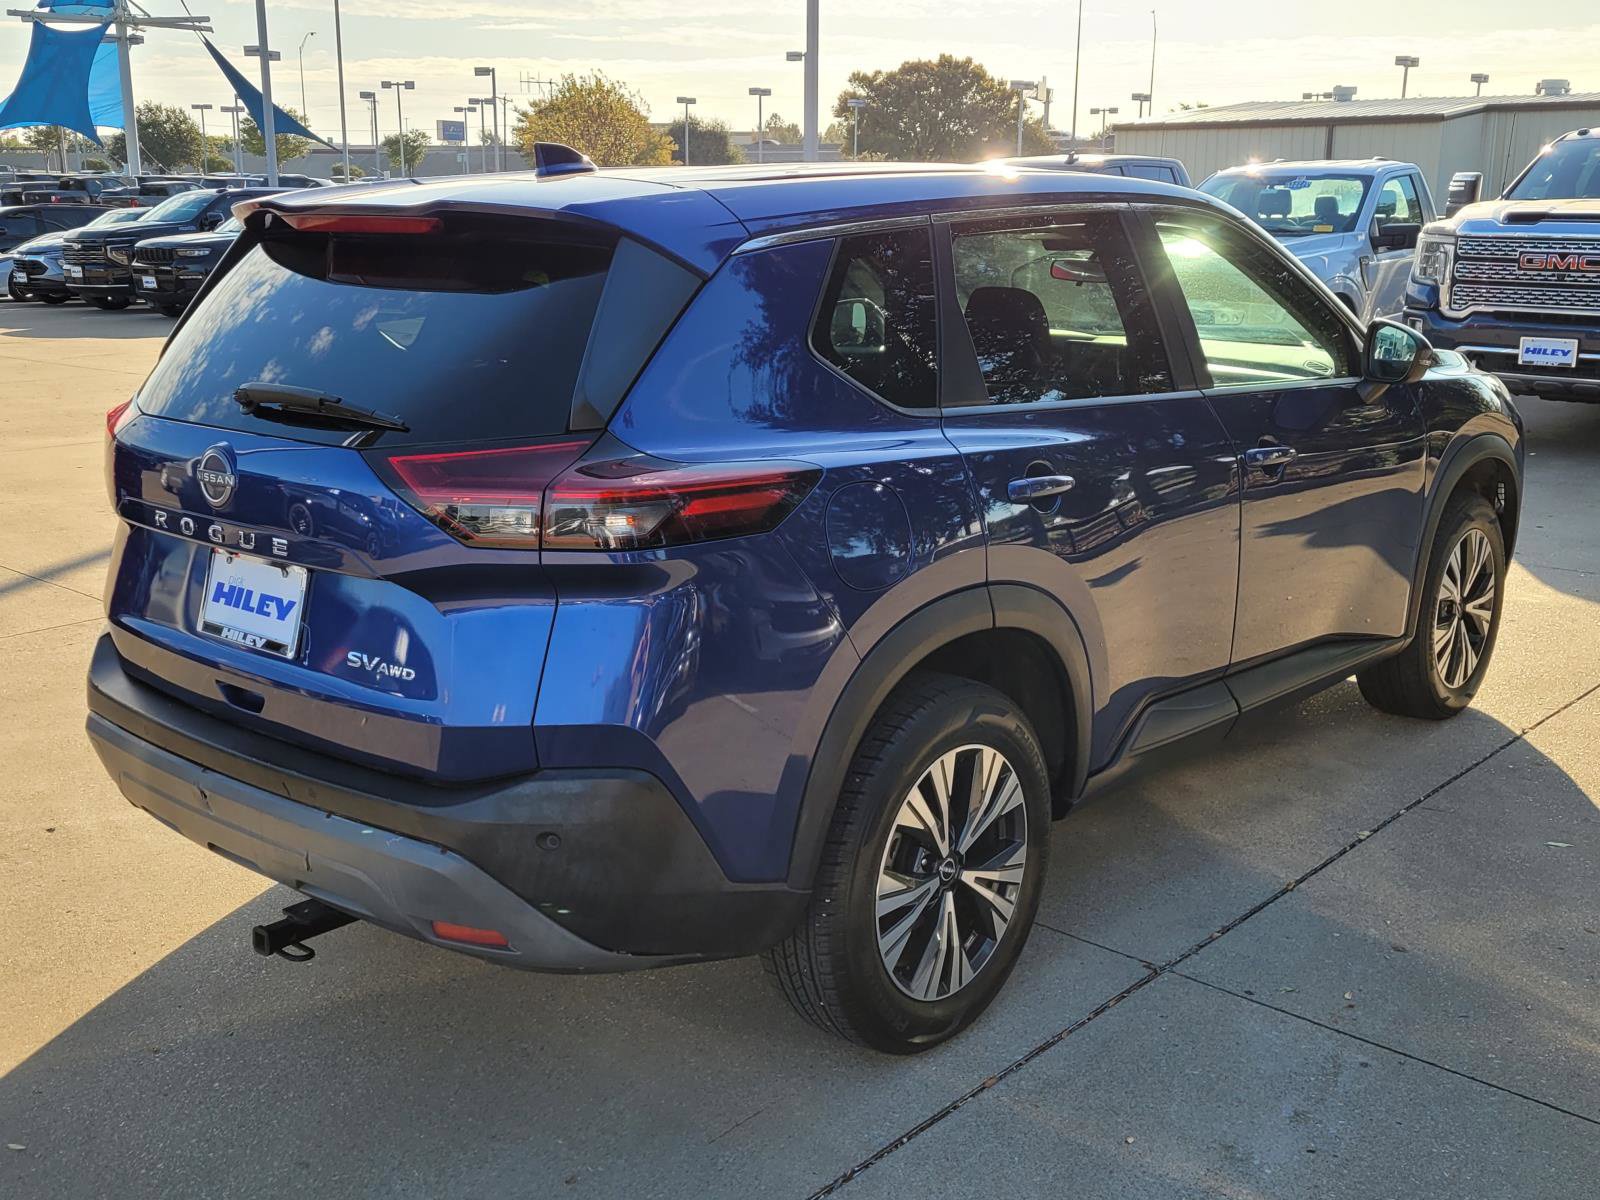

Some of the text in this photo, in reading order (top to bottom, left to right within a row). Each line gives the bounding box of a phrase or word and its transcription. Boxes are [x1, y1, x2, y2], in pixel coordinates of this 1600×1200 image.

[1519, 254, 1600, 270] GMC
[1524, 346, 1572, 357] HILEY
[197, 471, 234, 486] NISSAN
[155, 510, 288, 556] ROGUE
[212, 581, 296, 621] HILEY
[221, 626, 267, 648] HILEY
[346, 651, 416, 681] SV AWD
